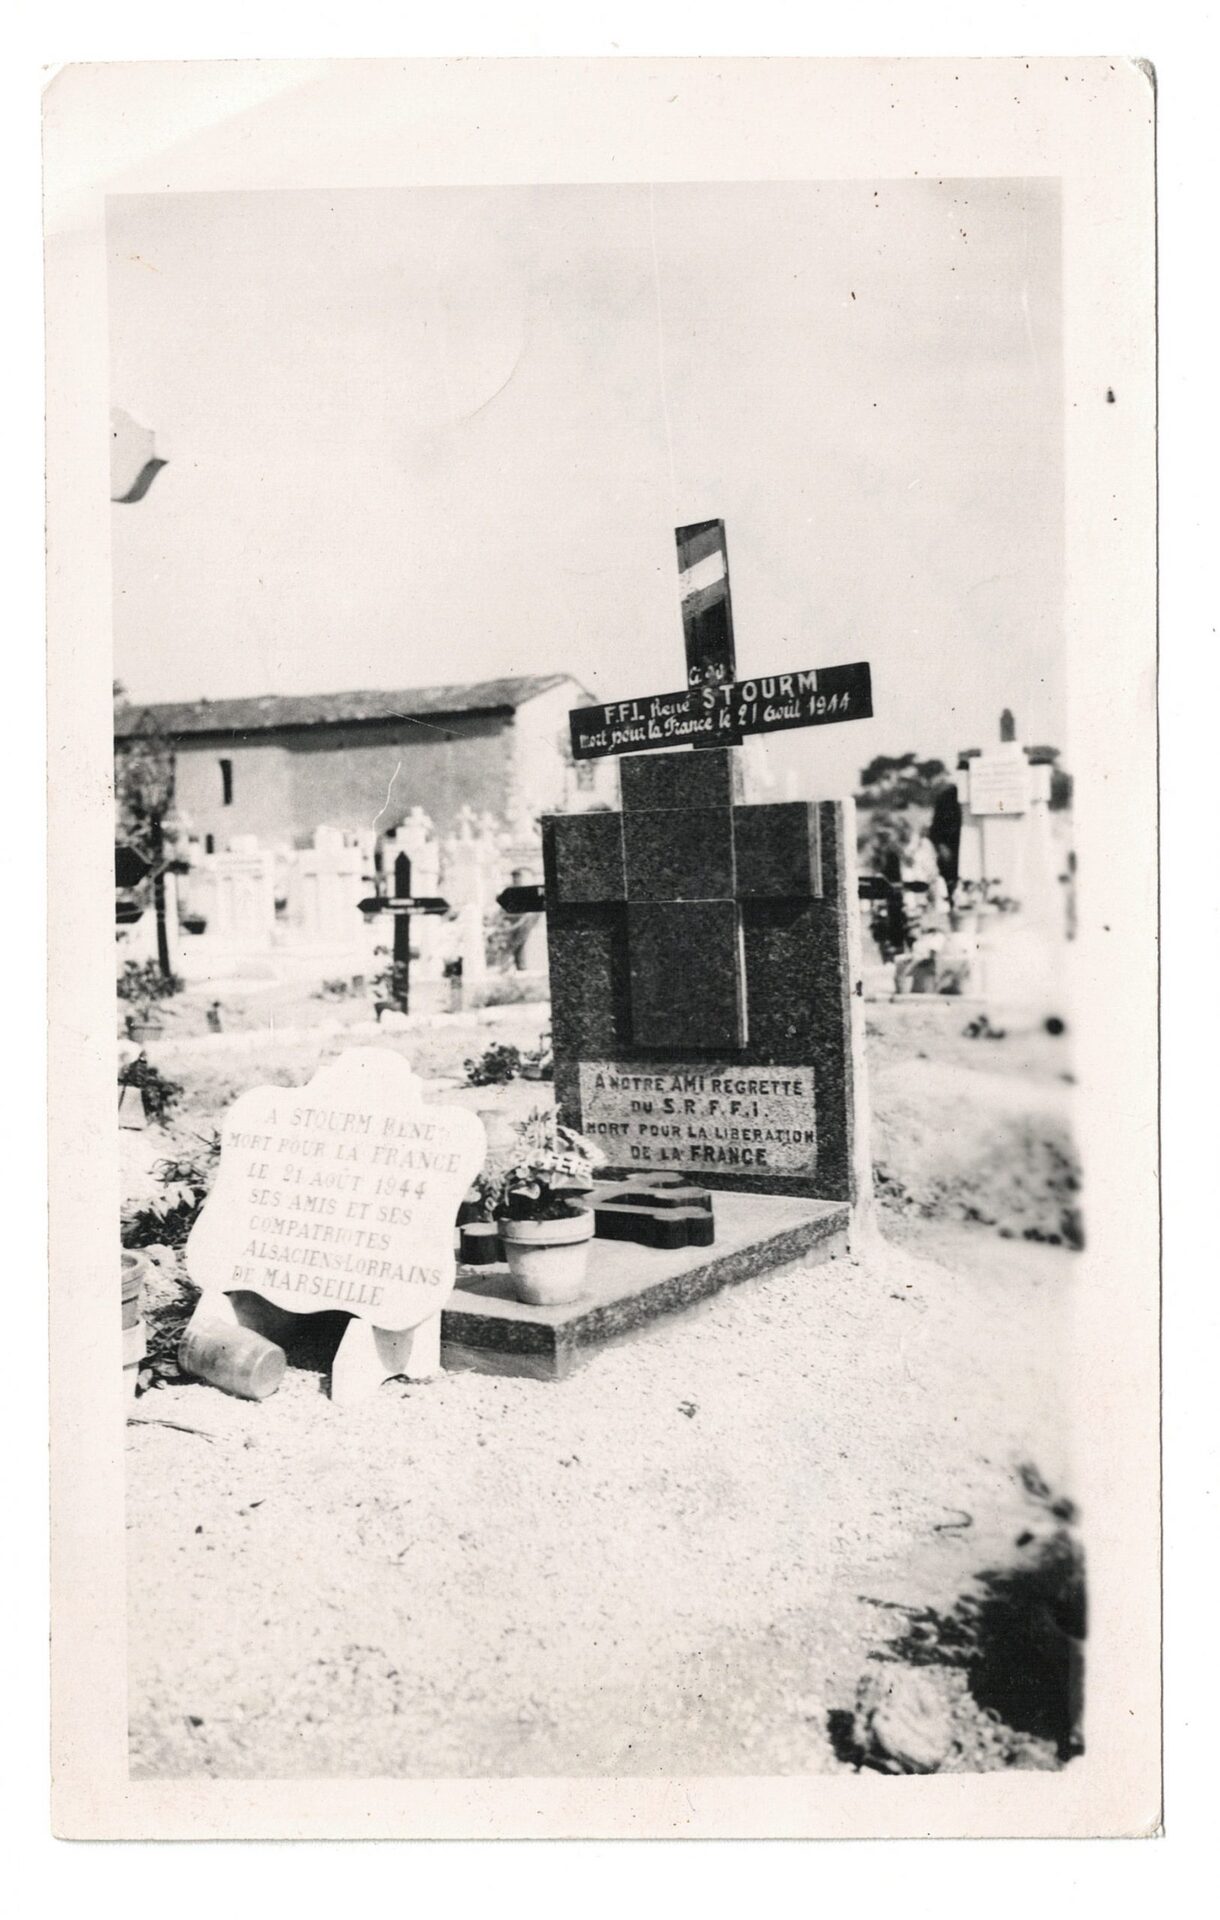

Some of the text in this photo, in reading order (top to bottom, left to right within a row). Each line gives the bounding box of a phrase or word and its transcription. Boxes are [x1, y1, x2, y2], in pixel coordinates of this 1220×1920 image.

[650, 694, 692, 718] René
[703, 670, 818, 709] STOURM
[608, 727, 646, 752] pour
[648, 719, 663, 739] la
[664, 715, 713, 737] France
[719, 707, 731, 728] le
[738, 702, 758, 726] 21
[807, 692, 851, 716] 1944
[609, 1076, 664, 1091] NOTRE
[671, 1075, 704, 1093] AMI
[292, 1108, 373, 1134] STOURM
[631, 1100, 652, 1114] DU
[586, 1123, 630, 1135] MORT
[639, 1124, 681, 1138] POUR
[688, 1127, 706, 1139] LA
[227, 1132, 461, 1173] MORT POUR LA FRANCE
[631, 1145, 767, 1166] DE LA FRANCE
[248, 1162, 269, 1180] LE
[283, 1163, 301, 1183] 21
[375, 1178, 426, 1200] 1944
[249, 1188, 412, 1225] SES AMIS ET SES
[250, 1216, 391, 1251] COMPATRIOTES
[232, 1265, 384, 1306] DE MARSEILLE
